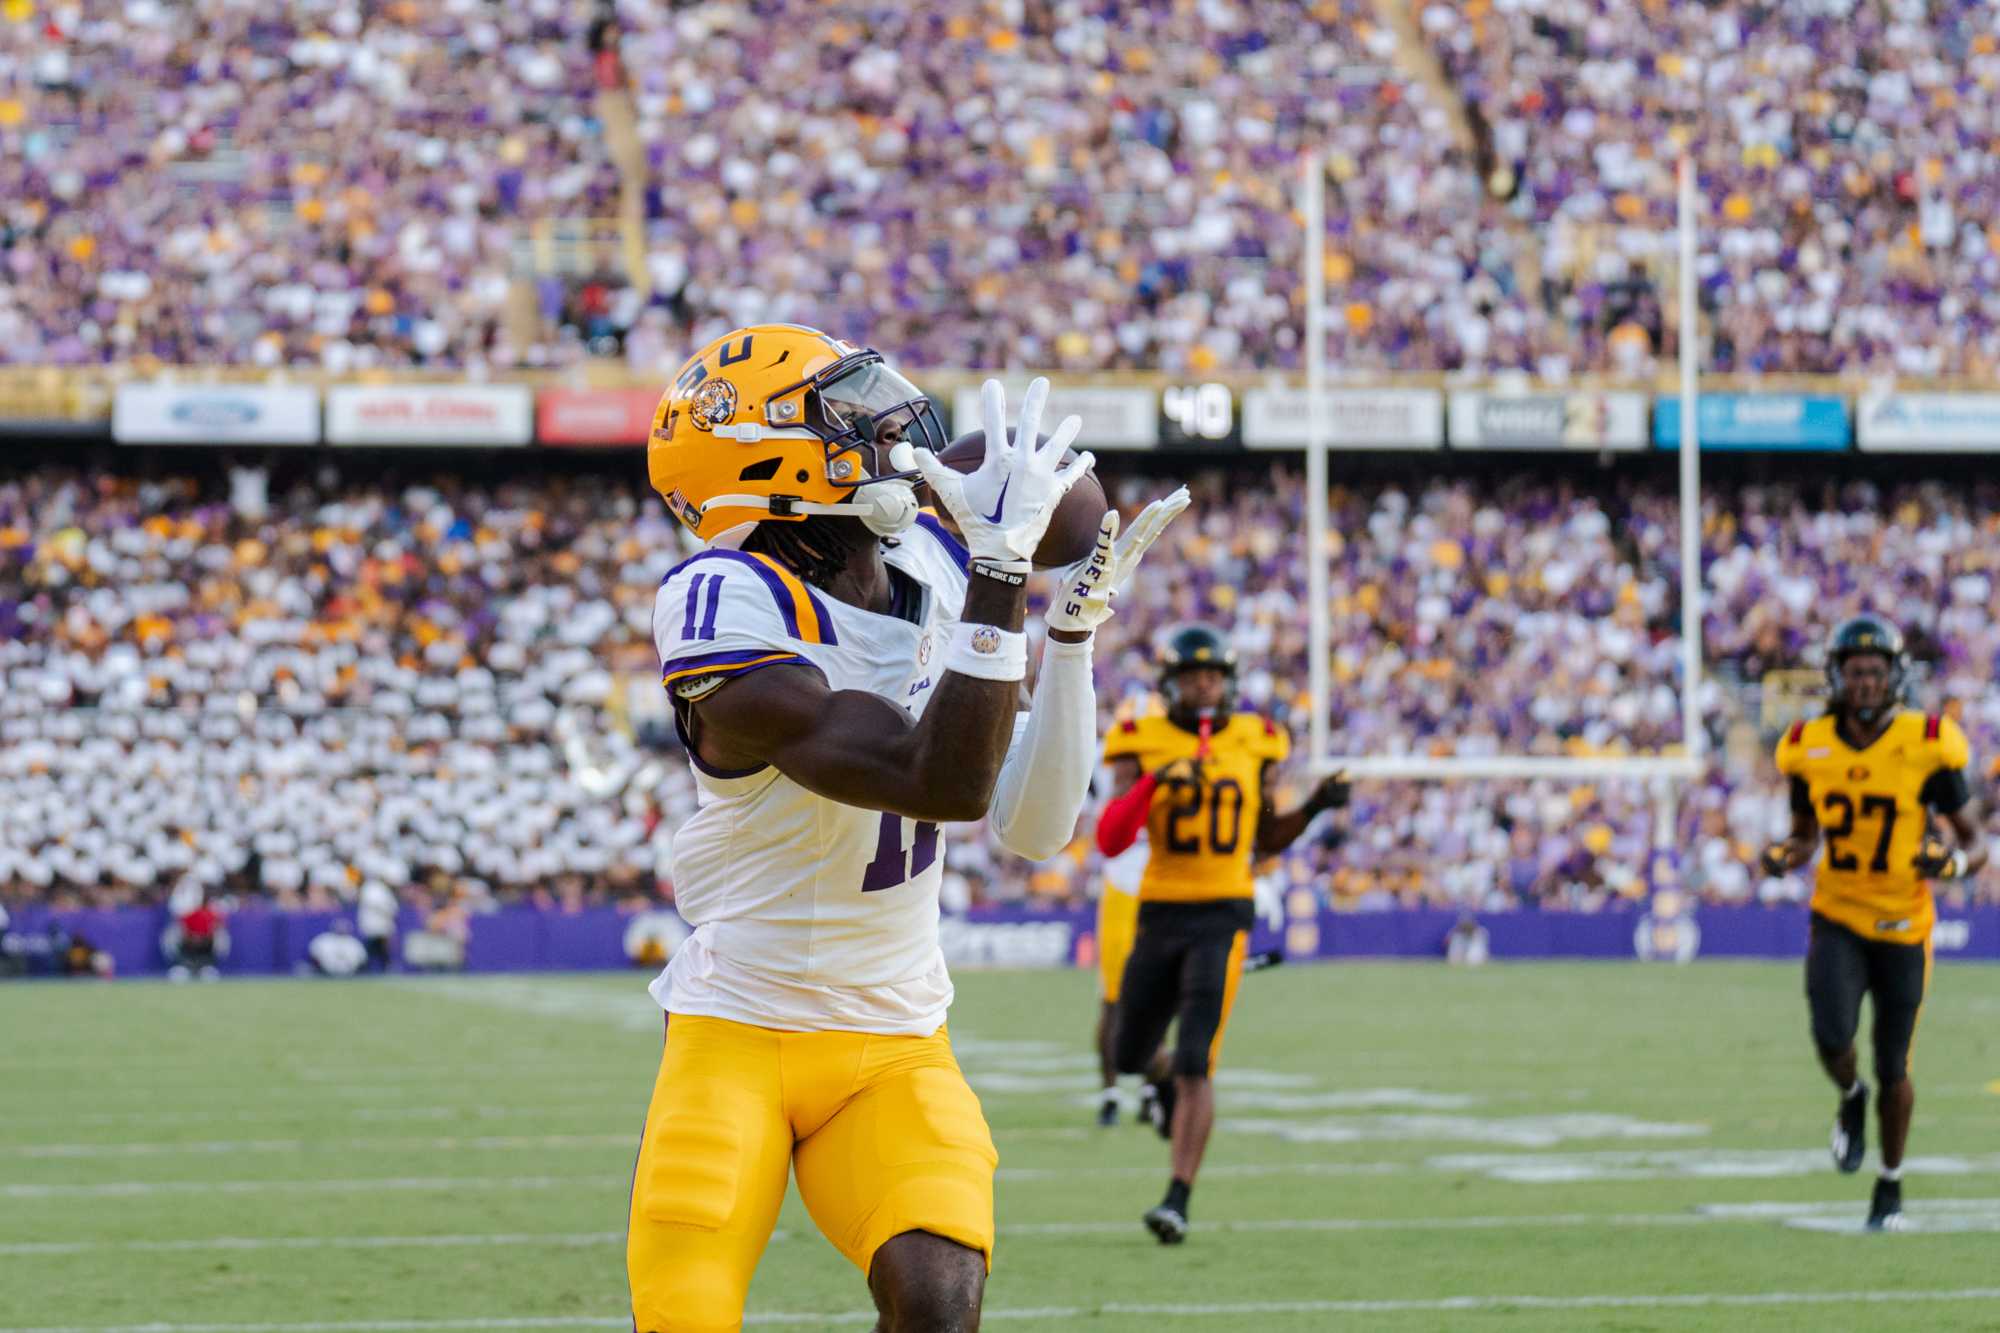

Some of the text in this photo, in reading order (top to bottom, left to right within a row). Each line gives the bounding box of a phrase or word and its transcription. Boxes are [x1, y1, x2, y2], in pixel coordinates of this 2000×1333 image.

[653, 334, 753, 442] LSU
[1163, 384, 1233, 439] 40
[681, 573, 726, 641] 11
[975, 564, 990, 577] ONE
[1007, 575, 1023, 585] REP
[1064, 527, 1113, 617] TIGERS
[861, 811, 941, 893] 11
[1167, 777, 1243, 855] 20
[1823, 792, 1898, 873] 27
